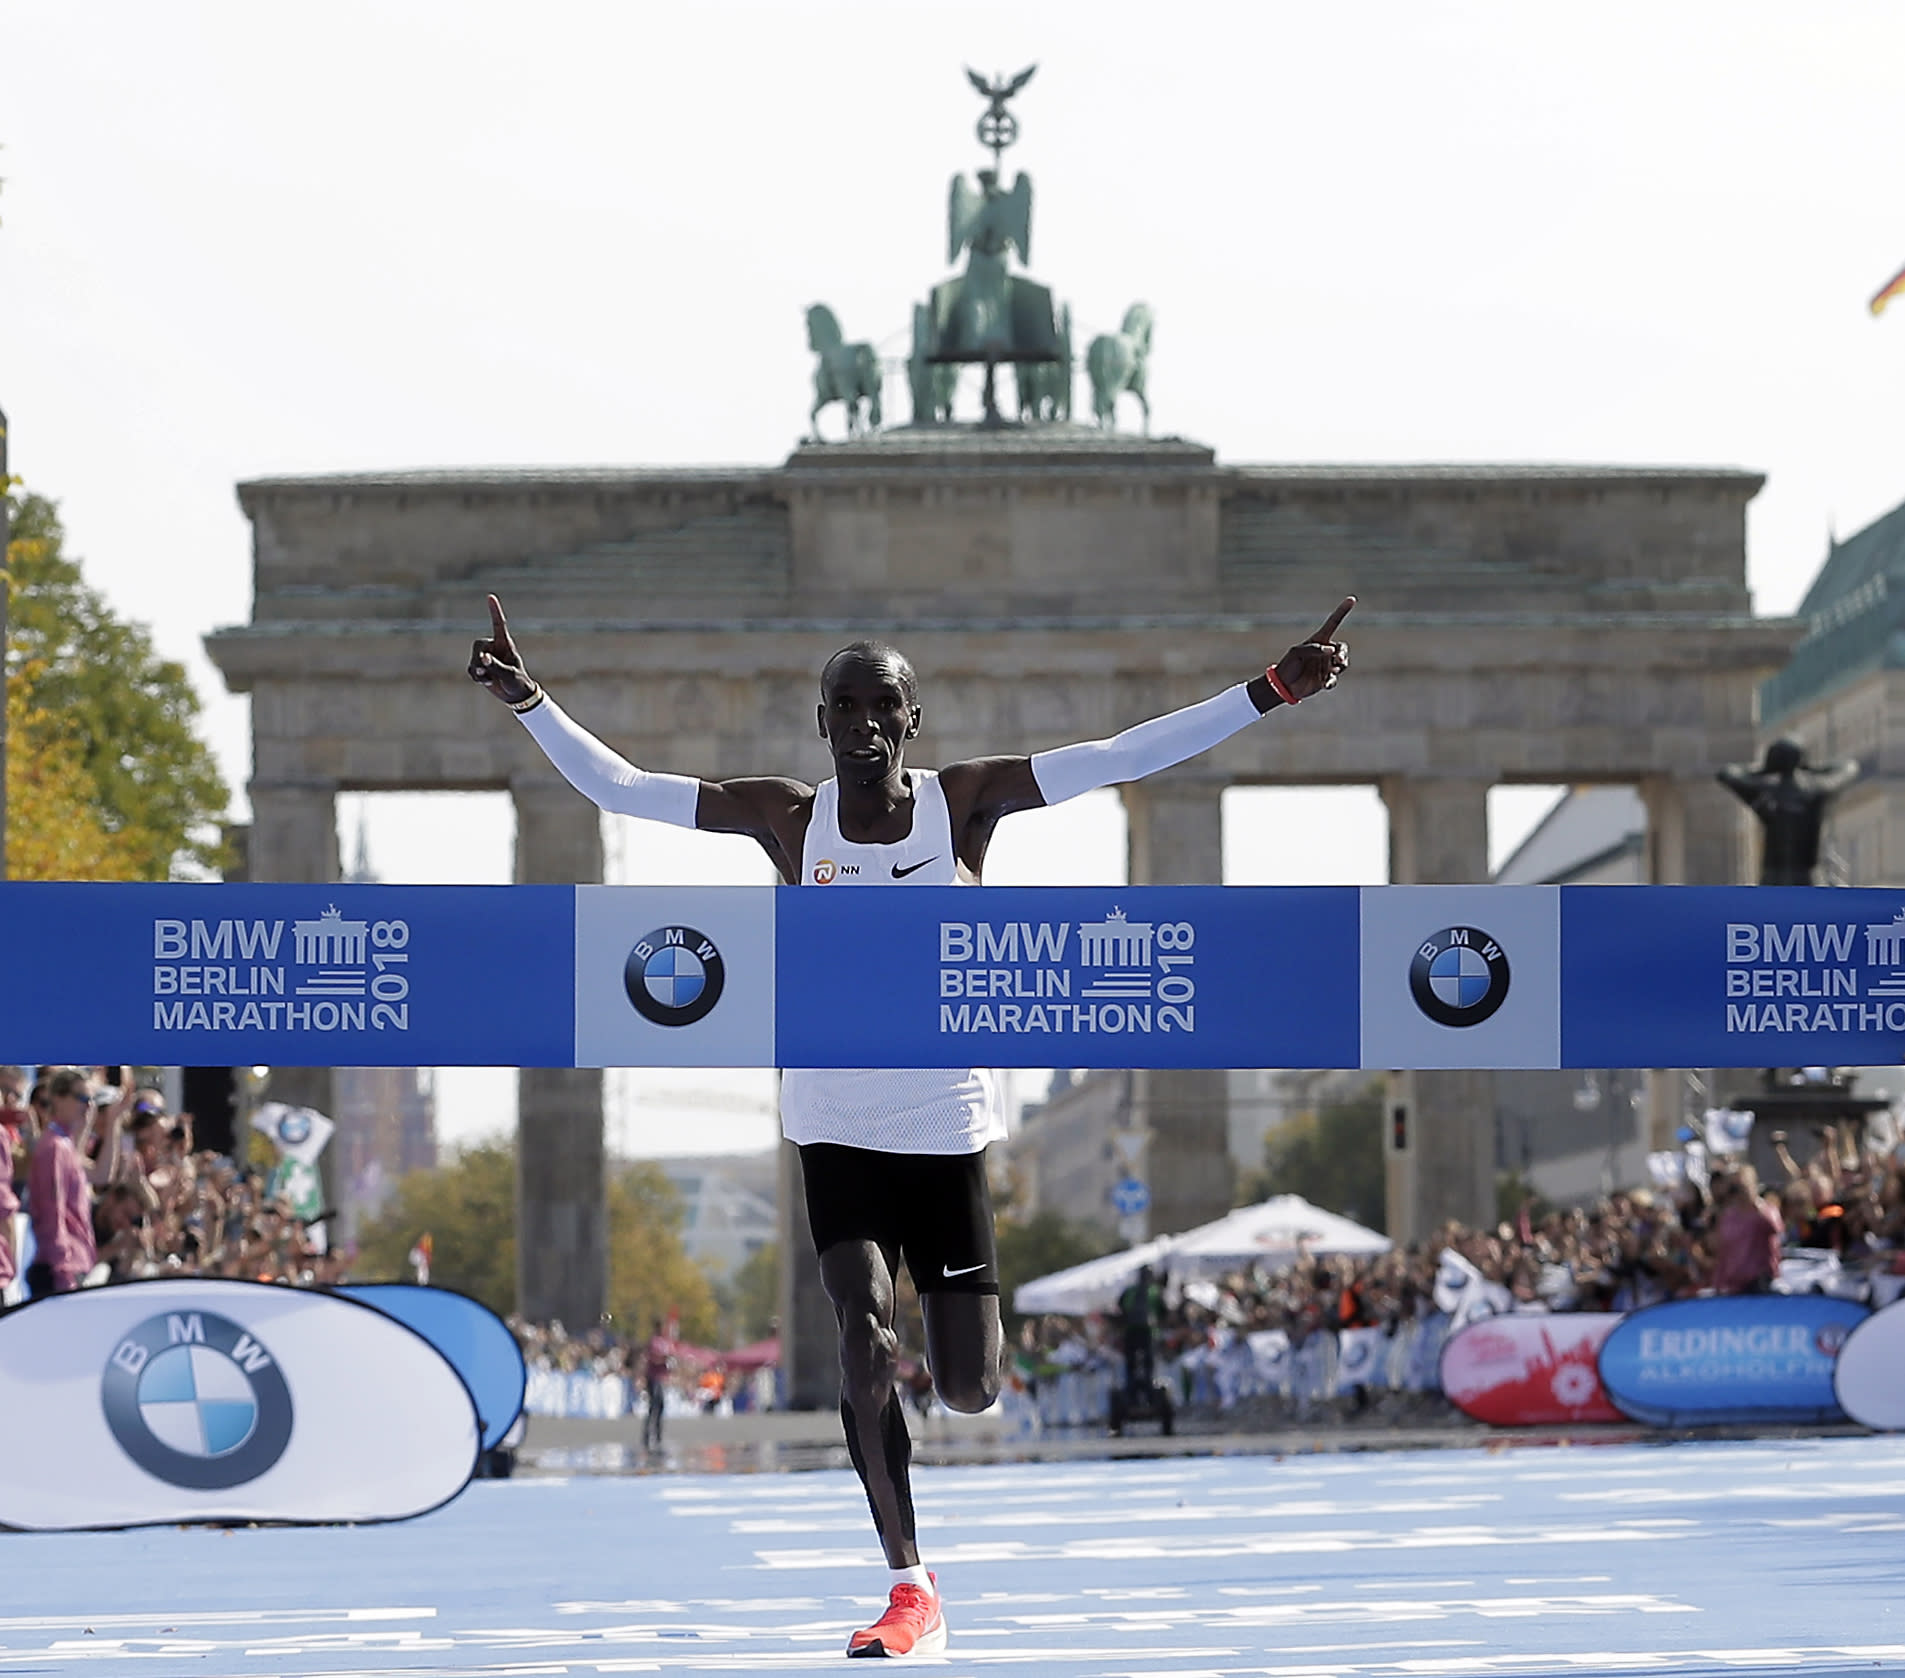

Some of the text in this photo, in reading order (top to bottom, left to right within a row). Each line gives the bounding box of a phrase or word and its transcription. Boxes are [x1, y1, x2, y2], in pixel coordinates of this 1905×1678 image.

[841, 865, 860, 875] NN
[154, 919, 285, 960] BMW
[634, 929, 717, 961] BMW
[939, 922, 1070, 962] BMW
[1418, 929, 1502, 961] BMW
[1726, 923, 1857, 963] BMW
[153, 966, 285, 995] BERLIN
[370, 920, 410, 1030] 2018
[939, 969, 1070, 998] BERLIN
[1156, 922, 1195, 1033] 2018
[1726, 968, 1857, 997] BERLIN
[153, 1001, 366, 1030] MARATHON
[939, 1004, 1152, 1033] MARATHON
[112, 1313, 272, 1376] BMW
[1640, 1323, 1812, 1361] ERDINGER
